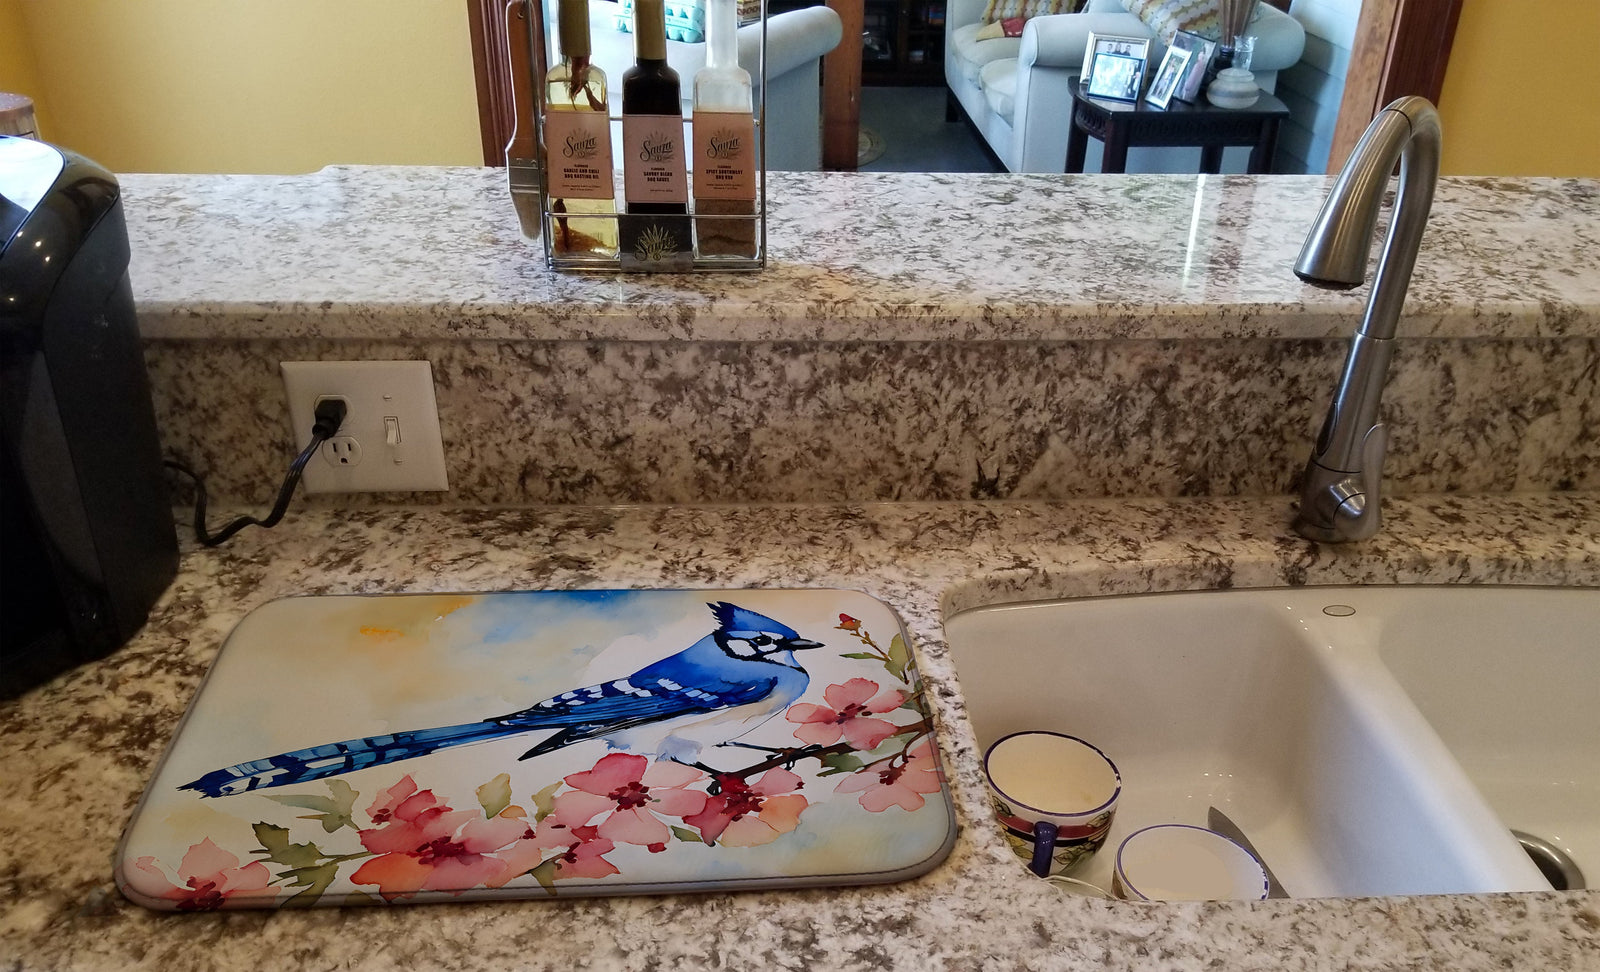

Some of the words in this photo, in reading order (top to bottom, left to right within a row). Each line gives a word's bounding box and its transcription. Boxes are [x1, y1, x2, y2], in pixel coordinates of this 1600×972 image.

[563, 136, 597, 158] Sauza
[640, 140, 674, 162] Sauza
[707, 136, 740, 159] Sauza
